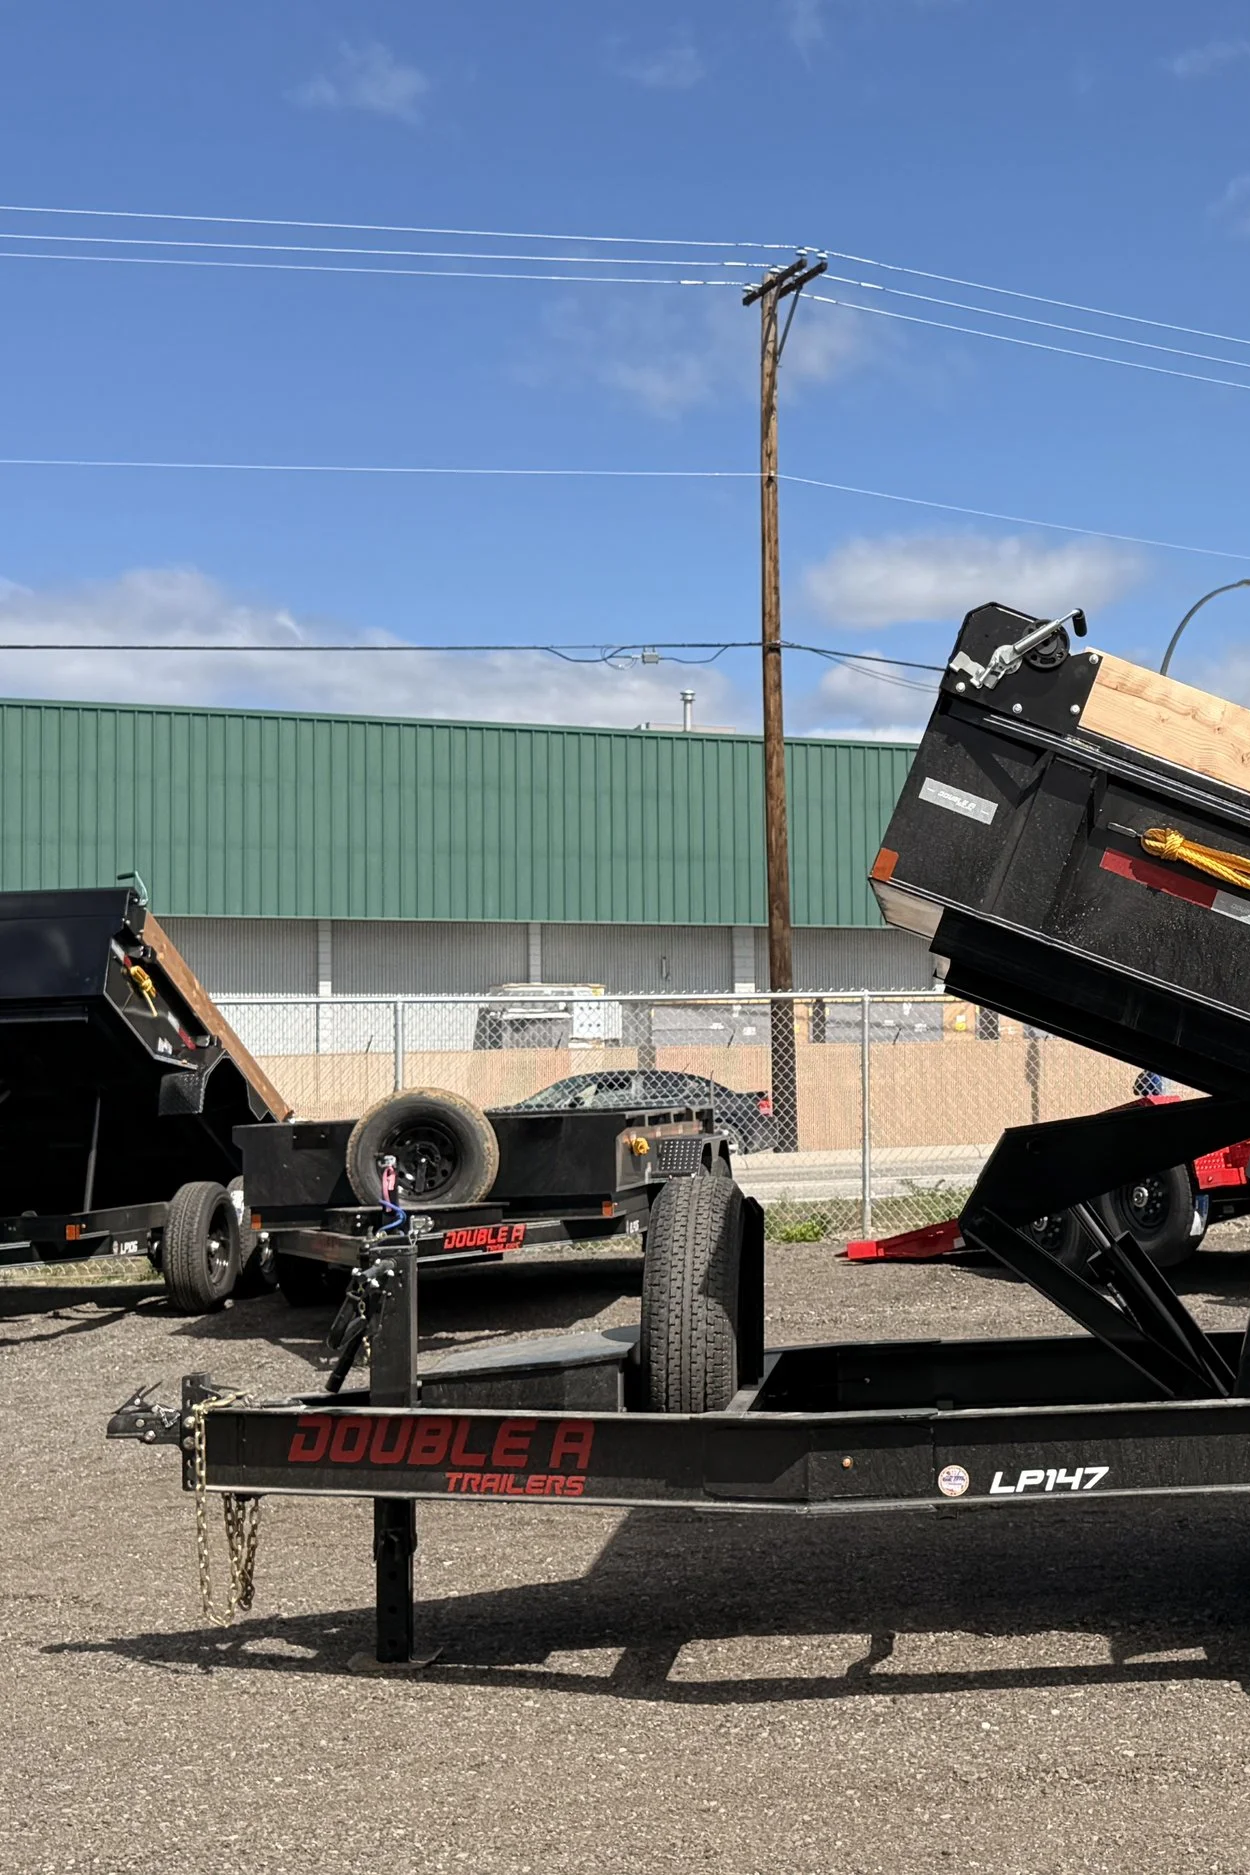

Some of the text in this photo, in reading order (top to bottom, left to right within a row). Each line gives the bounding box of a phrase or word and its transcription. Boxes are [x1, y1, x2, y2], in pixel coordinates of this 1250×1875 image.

[443, 1223, 526, 1249] DOUBLE A
[287, 1413, 595, 1469] DOUBLE A
[444, 1472, 586, 1496] TRAILERS
[989, 1466, 1110, 1495] LP147
